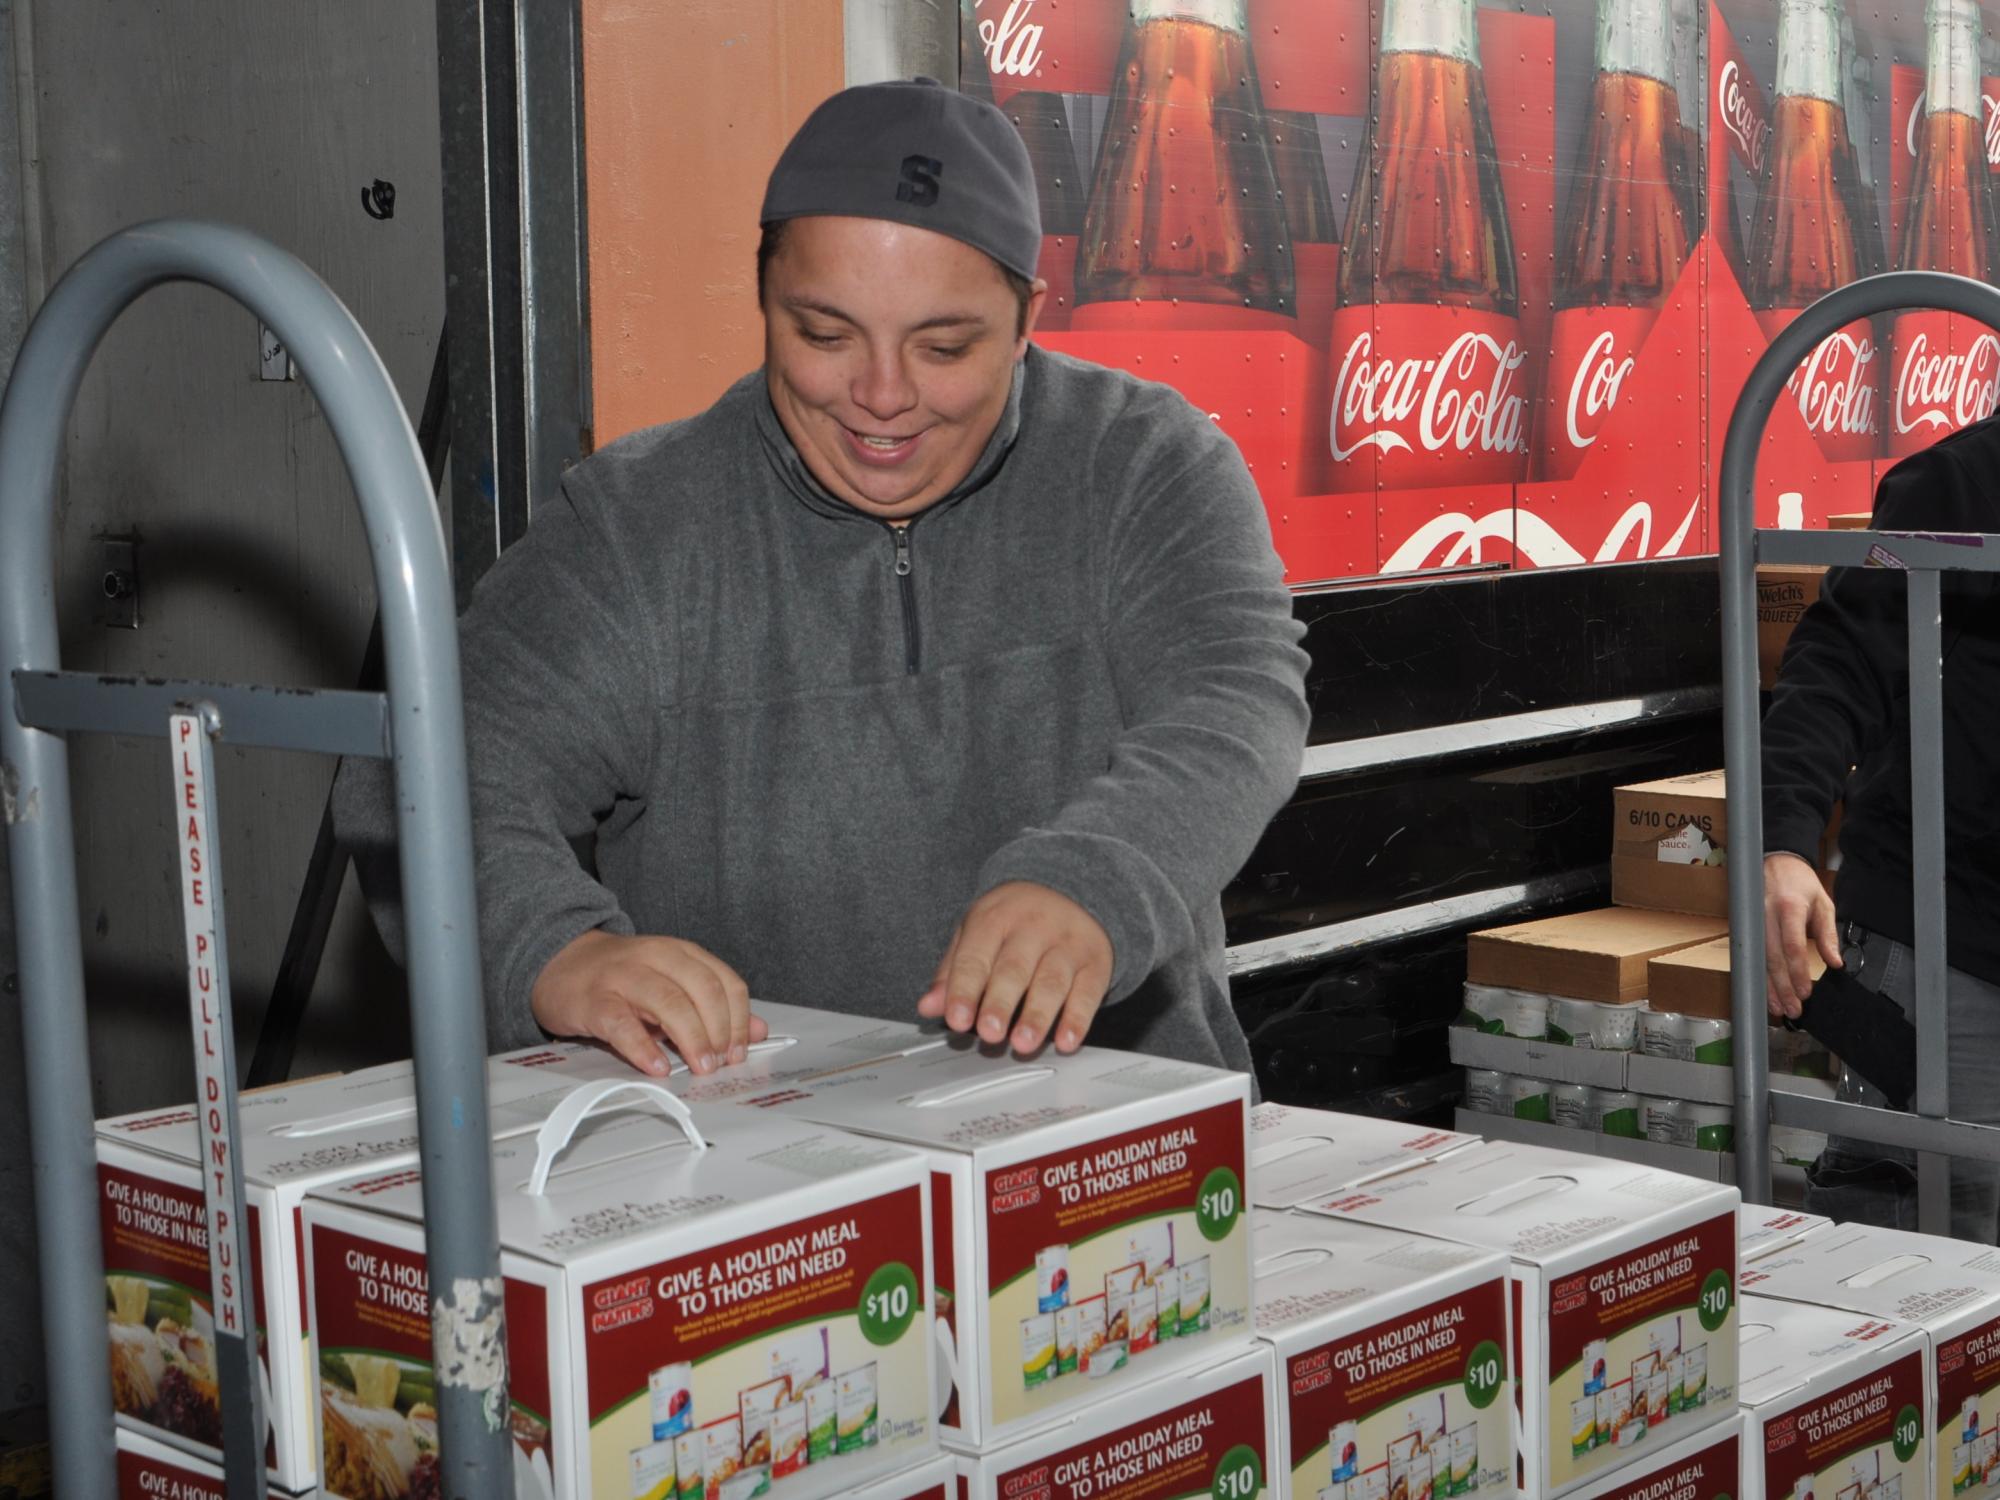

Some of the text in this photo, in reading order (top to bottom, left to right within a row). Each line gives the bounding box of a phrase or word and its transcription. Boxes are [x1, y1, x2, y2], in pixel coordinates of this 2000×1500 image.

[896, 154, 943, 208] S
[1330, 332, 1524, 461] Coca-Cola
[1758, 585, 1804, 602] Welch's
[1758, 607, 1801, 623] SQUEEZ
[1630, 810, 1712, 831] 6/10 CANS
[181, 720, 204, 905] PLEASE
[196, 934, 214, 1056] PULL
[217, 1211, 236, 1330] PUSH
[1043, 1127, 1197, 1188] GIVE A HOLIDAY MEAL
[1058, 1183, 1080, 1205] TO
[1083, 1171, 1131, 1198] THOSE
[1133, 1160, 1149, 1180] IN
[1152, 1151, 1187, 1177] NEED
[106, 1180, 130, 1203] GIVE
[132, 1189, 142, 1206] A
[142, 1191, 193, 1220] HOLIDAY
[1202, 1188, 1234, 1221] $10
[115, 1204, 208, 1248] TO THOSE IN NEE
[346, 1250, 429, 1291] GIVE A HOLI
[658, 1219, 861, 1299] GIVE A HOLIDAY MEAL
[1589, 1236, 1700, 1292] GIVE A HOLIDAY MEAL
[358, 1276, 429, 1316] TO THOSE
[594, 1277, 650, 1309] GIANT
[677, 1247, 847, 1318] TO THOSE IN NEED
[1600, 1257, 1692, 1306] TO THOSE IN NEED
[1703, 1286, 1726, 1314] $10
[866, 1284, 909, 1323] $10
[1334, 1306, 1465, 1370] GIVE A HOLIDAY MEAL
[1347, 1329, 1456, 1384] TO THOSE IN NEED
[1966, 1335, 1985, 1355] GIVE
[1986, 1333, 1993, 1346] A
[1974, 1351, 1986, 1366] TO
[1470, 1359, 1497, 1389] $10
[1798, 1375, 1894, 1431] GIVE A HOLIDAY MEAL
[1808, 1395, 1887, 1443] TO THOSE IN NEED
[1054, 1456, 1089, 1486] GIVE
[1093, 1451, 1104, 1471] A
[1108, 1424, 1173, 1462] HOLIDAY
[1176, 1408, 1214, 1438] MEAL
[1897, 1420, 1917, 1446] $10
[140, 1470, 168, 1495] GIVE
[171, 1481, 180, 1499] A
[1070, 1475, 1094, 1500] TO
[1096, 1461, 1144, 1493] THOSE
[1147, 1448, 1163, 1471] IN
[1166, 1434, 1203, 1463] NEED
[1219, 1465, 1253, 1499] $10
[1676, 1463, 1704, 1487] MEAL
